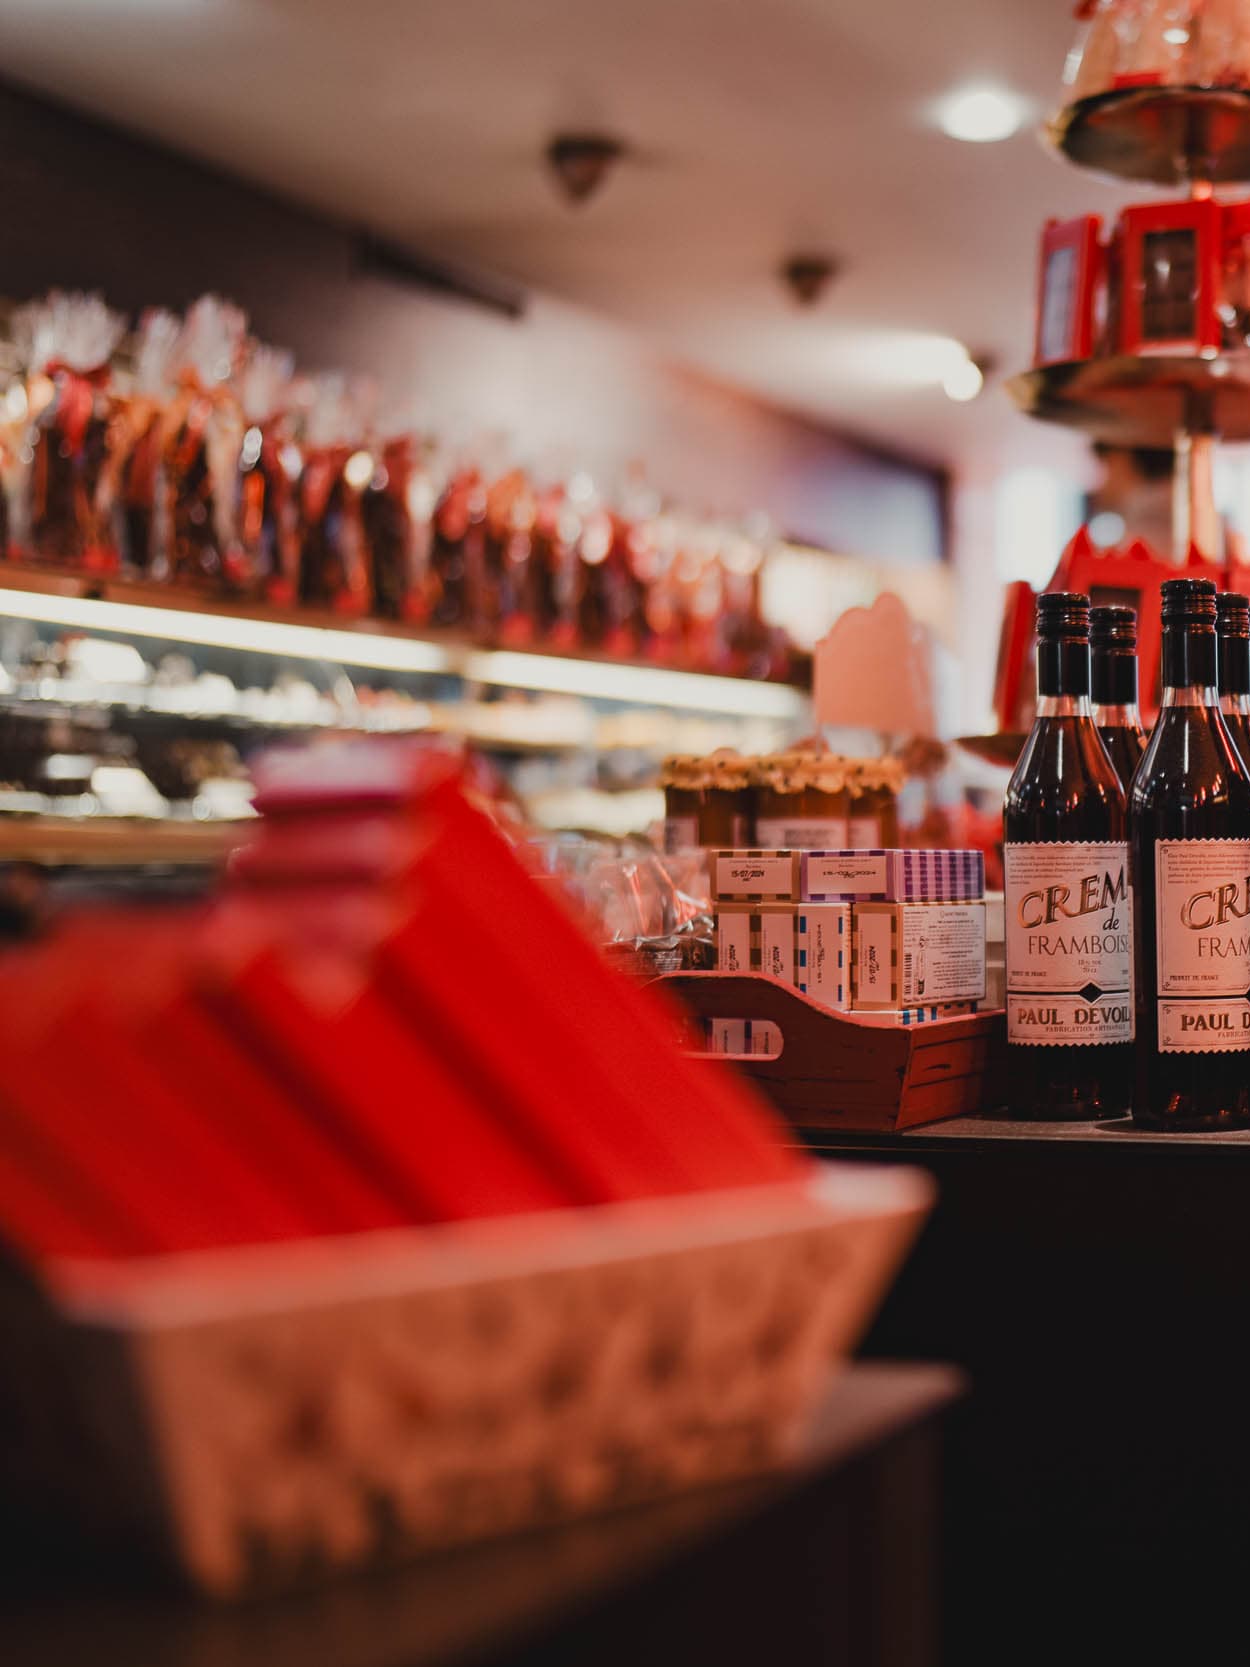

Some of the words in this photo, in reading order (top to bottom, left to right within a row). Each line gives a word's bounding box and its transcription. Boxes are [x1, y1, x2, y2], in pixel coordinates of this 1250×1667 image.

[1017, 864, 1127, 929] CREM
[1103, 907, 1119, 931] de
[1017, 1008, 1064, 1025] PAUL
[1074, 1006, 1130, 1025] DEVOIL
[1181, 1012, 1234, 1031] PAUL
